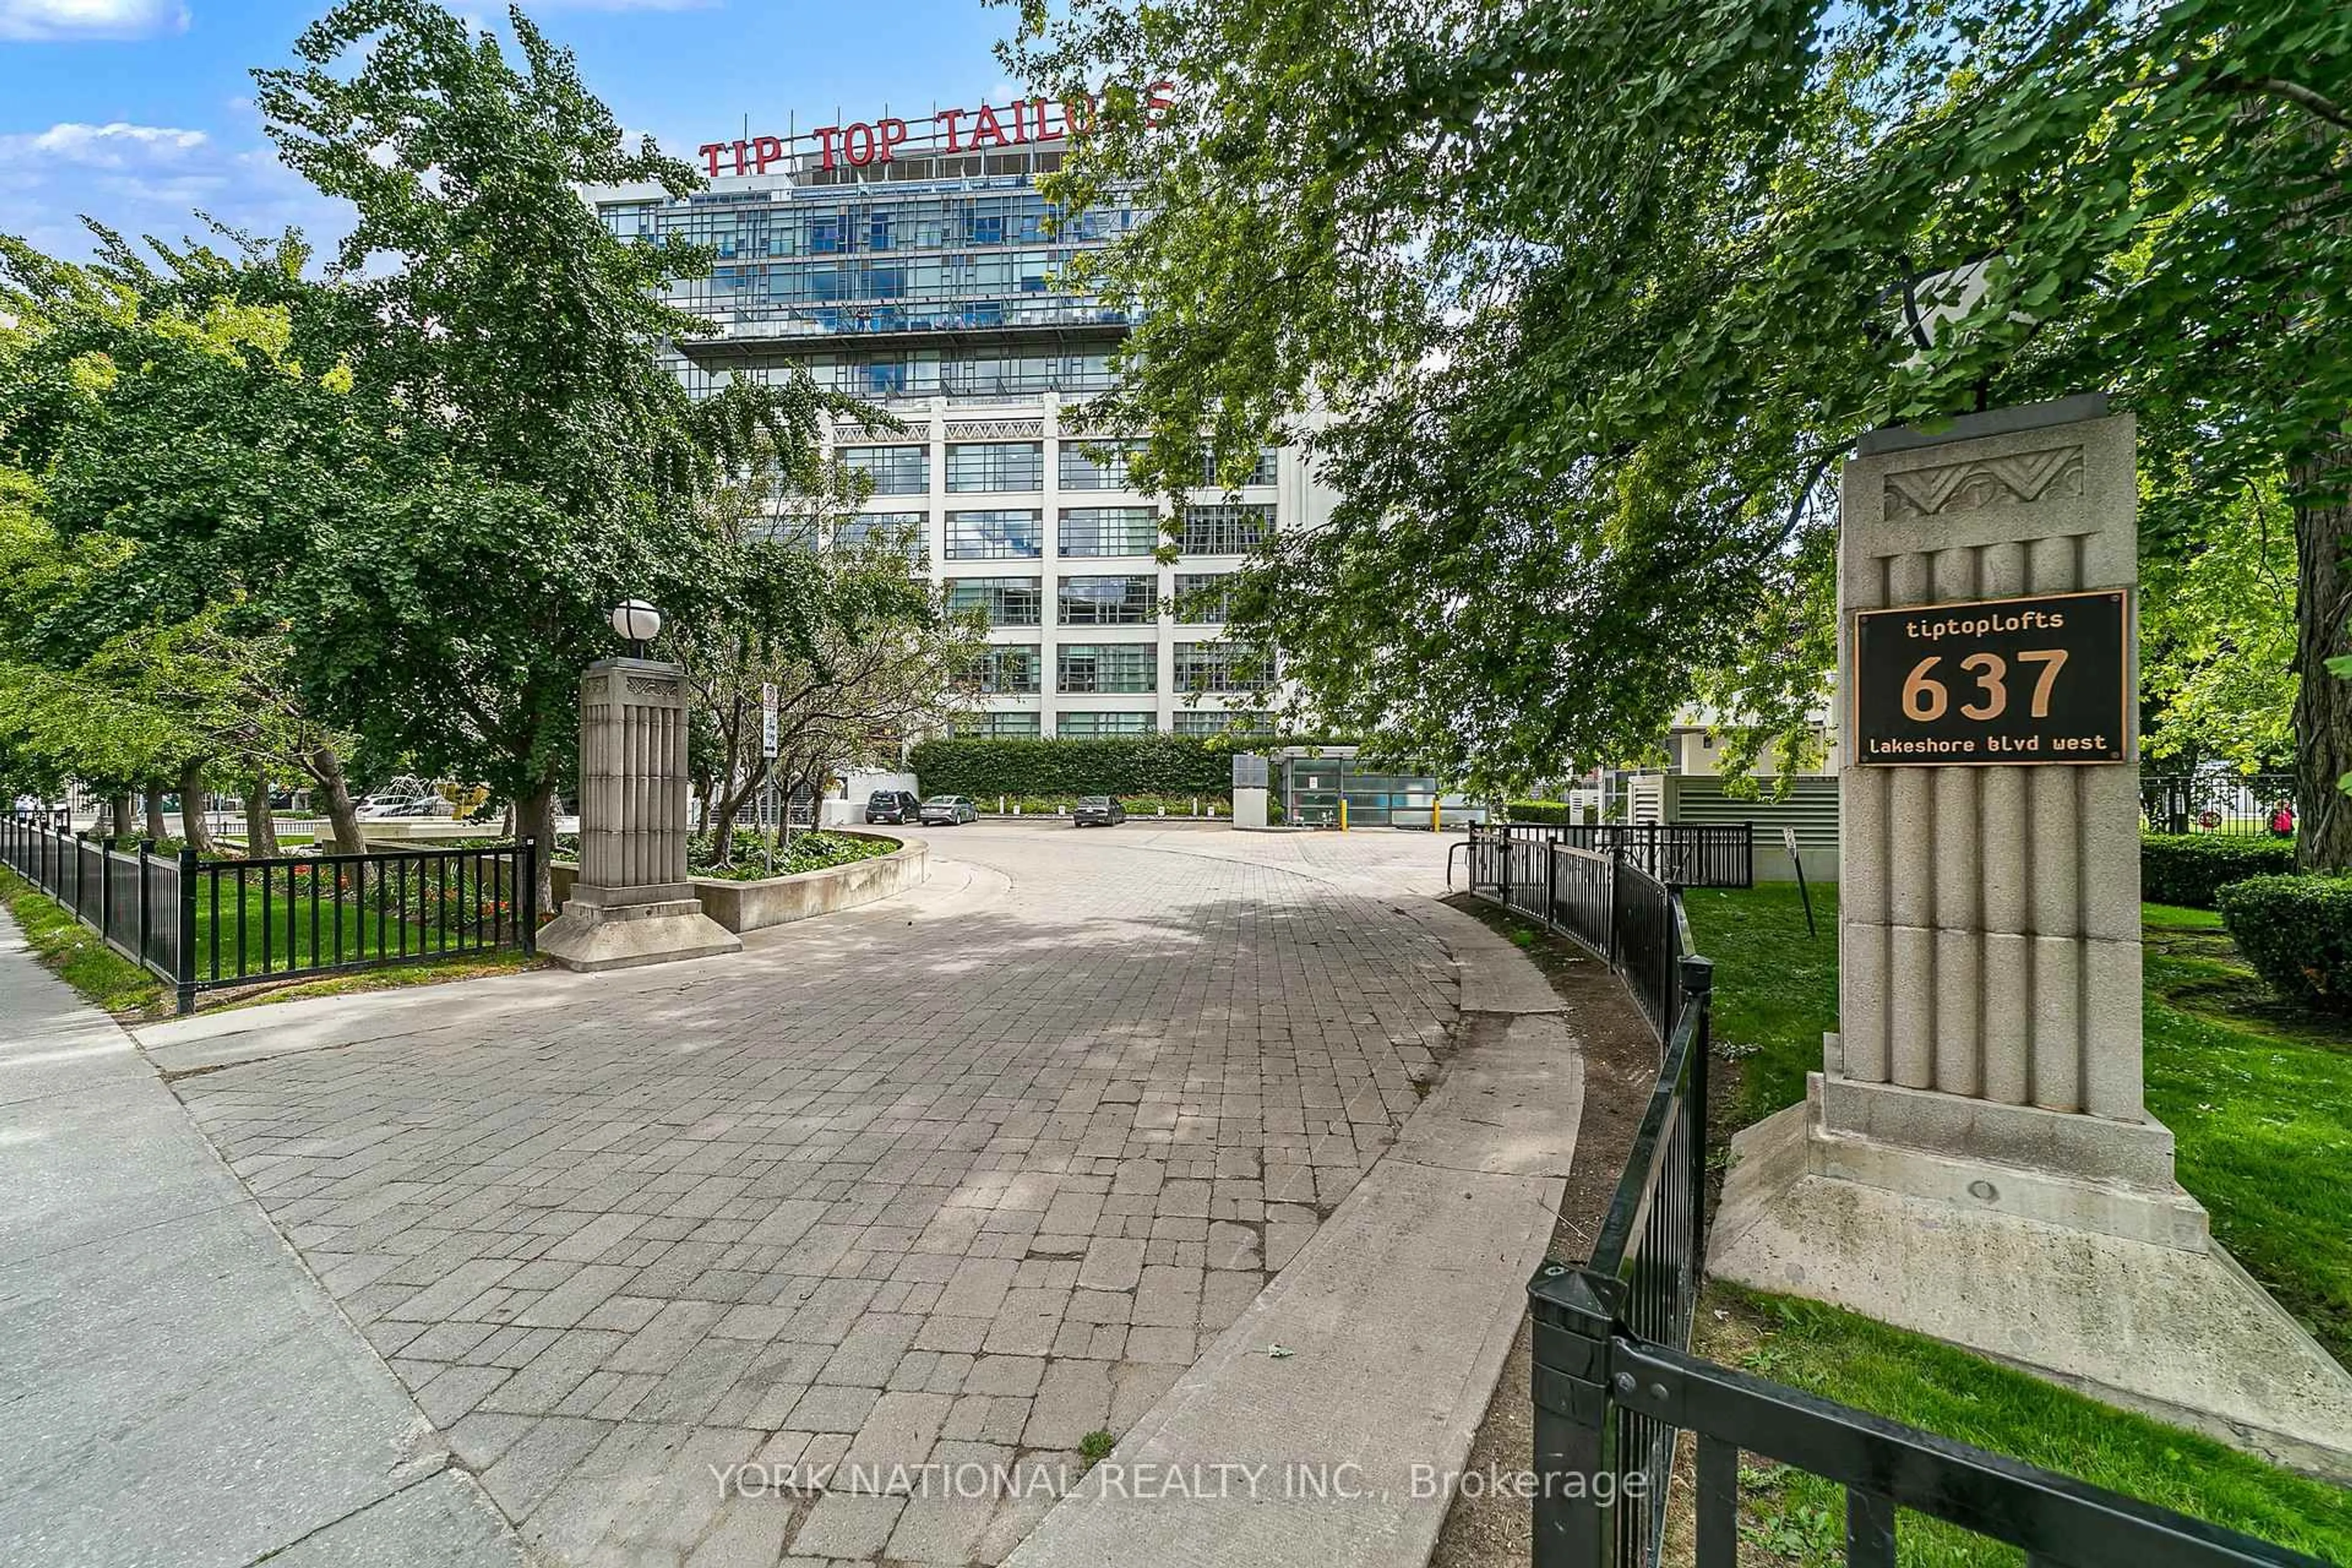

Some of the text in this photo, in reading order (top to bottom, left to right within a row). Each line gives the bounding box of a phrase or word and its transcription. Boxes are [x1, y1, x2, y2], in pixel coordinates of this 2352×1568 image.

[699, 81, 1175, 177] TIP TOP TAILOS
[1906, 611, 2064, 641] tiptoplofts
[1902, 649, 2069, 722] 637
[1870, 734, 2108, 754] lakeshore blvd west
